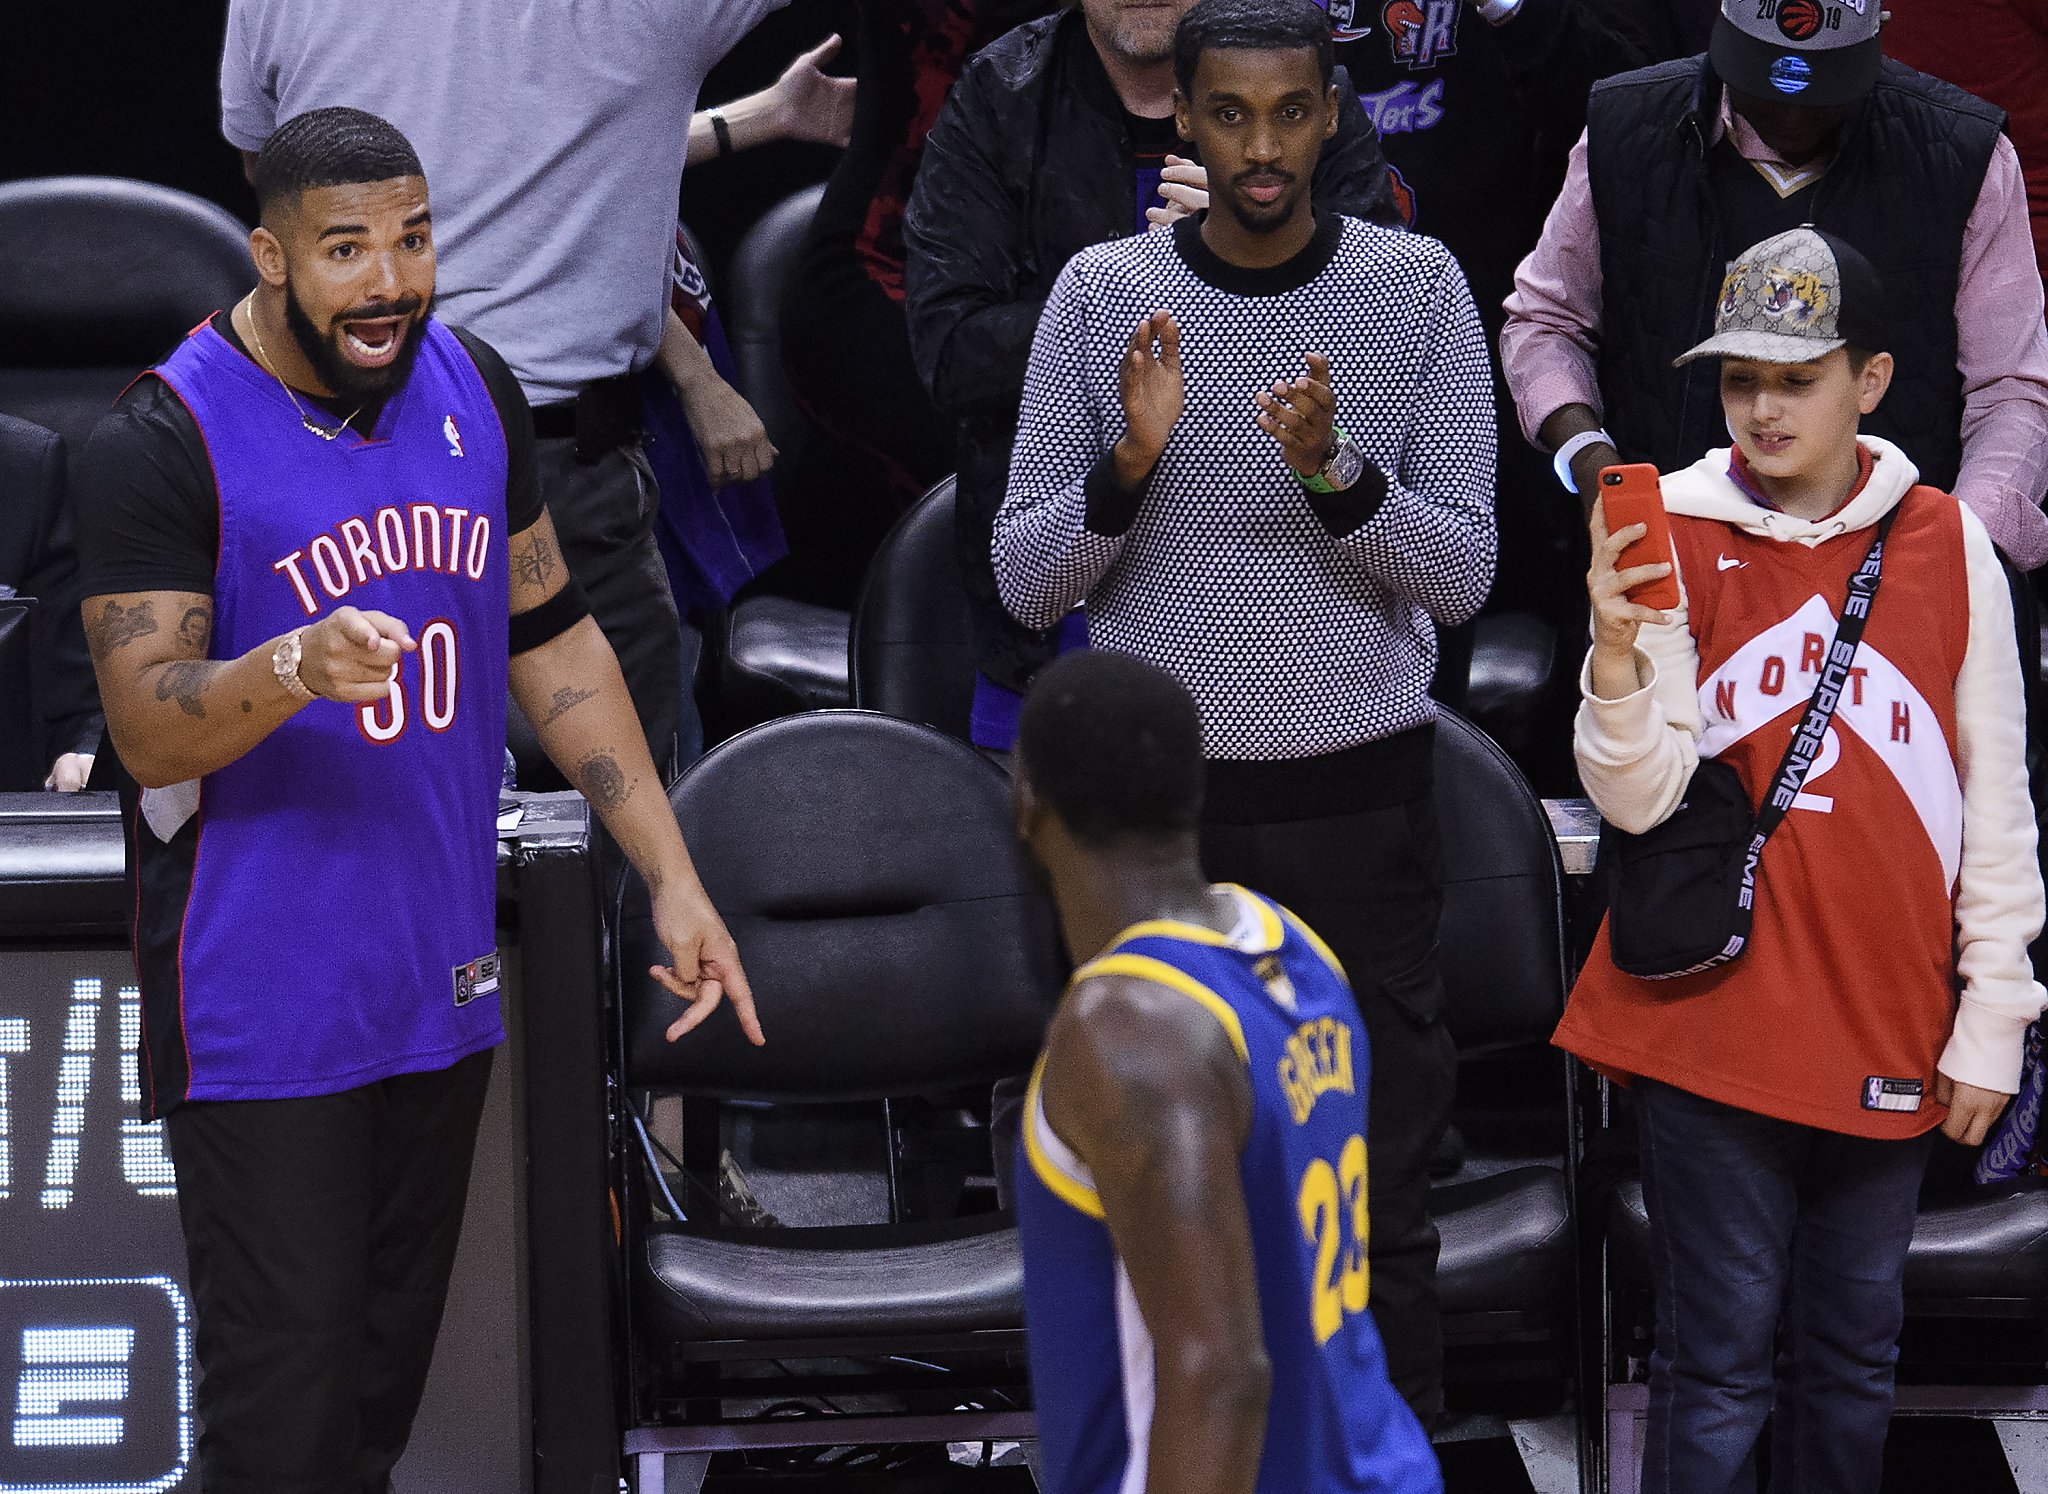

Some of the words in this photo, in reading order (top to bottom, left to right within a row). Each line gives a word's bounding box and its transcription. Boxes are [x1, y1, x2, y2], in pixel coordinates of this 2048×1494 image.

[1825, 7, 1842, 30] 19
[273, 502, 491, 616] TORONTO
[1716, 632, 1911, 745] NORTH
[1772, 640, 1855, 811] SUPREME
[1277, 1015, 1356, 1125] GREEN
[1298, 1133, 1370, 1347] 23
